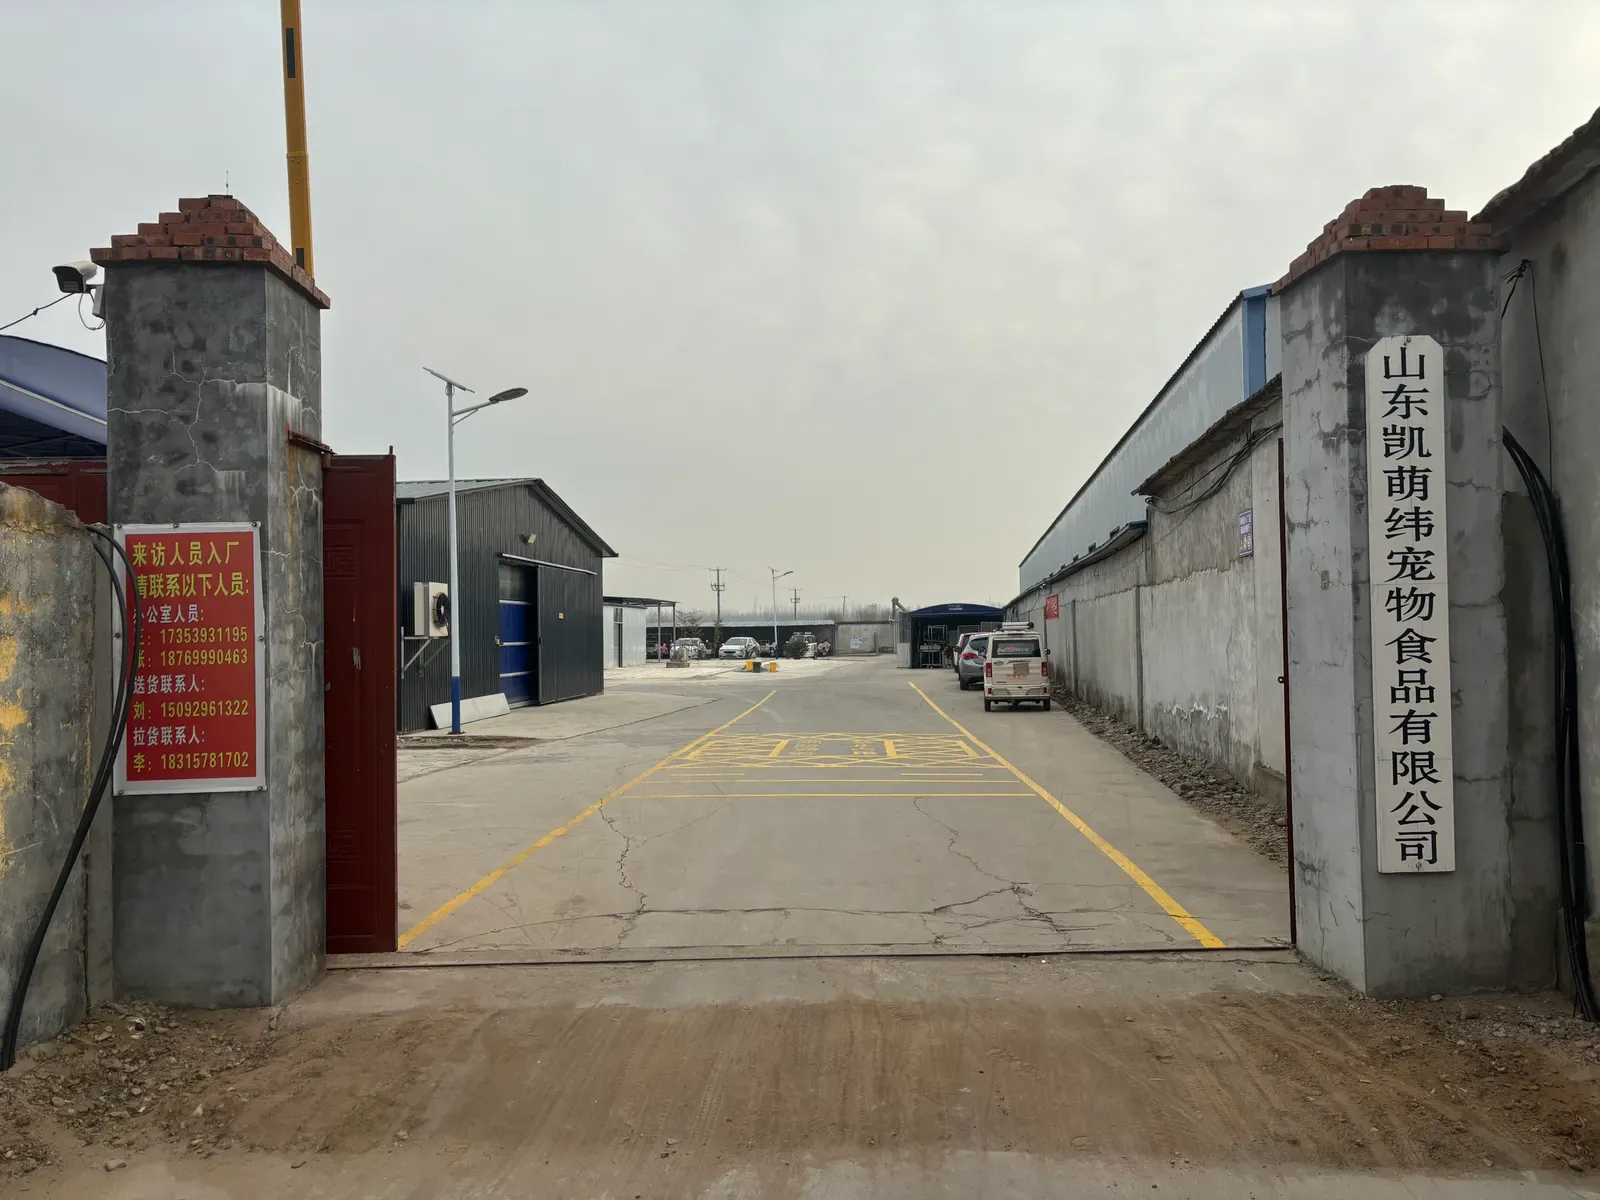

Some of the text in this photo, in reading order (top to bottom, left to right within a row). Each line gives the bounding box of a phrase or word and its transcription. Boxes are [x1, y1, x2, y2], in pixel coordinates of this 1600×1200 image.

[132, 541, 240, 567] 来访人员入厂
[1381, 346, 1443, 865] 山东凯萌纬宠物食品有限公司
